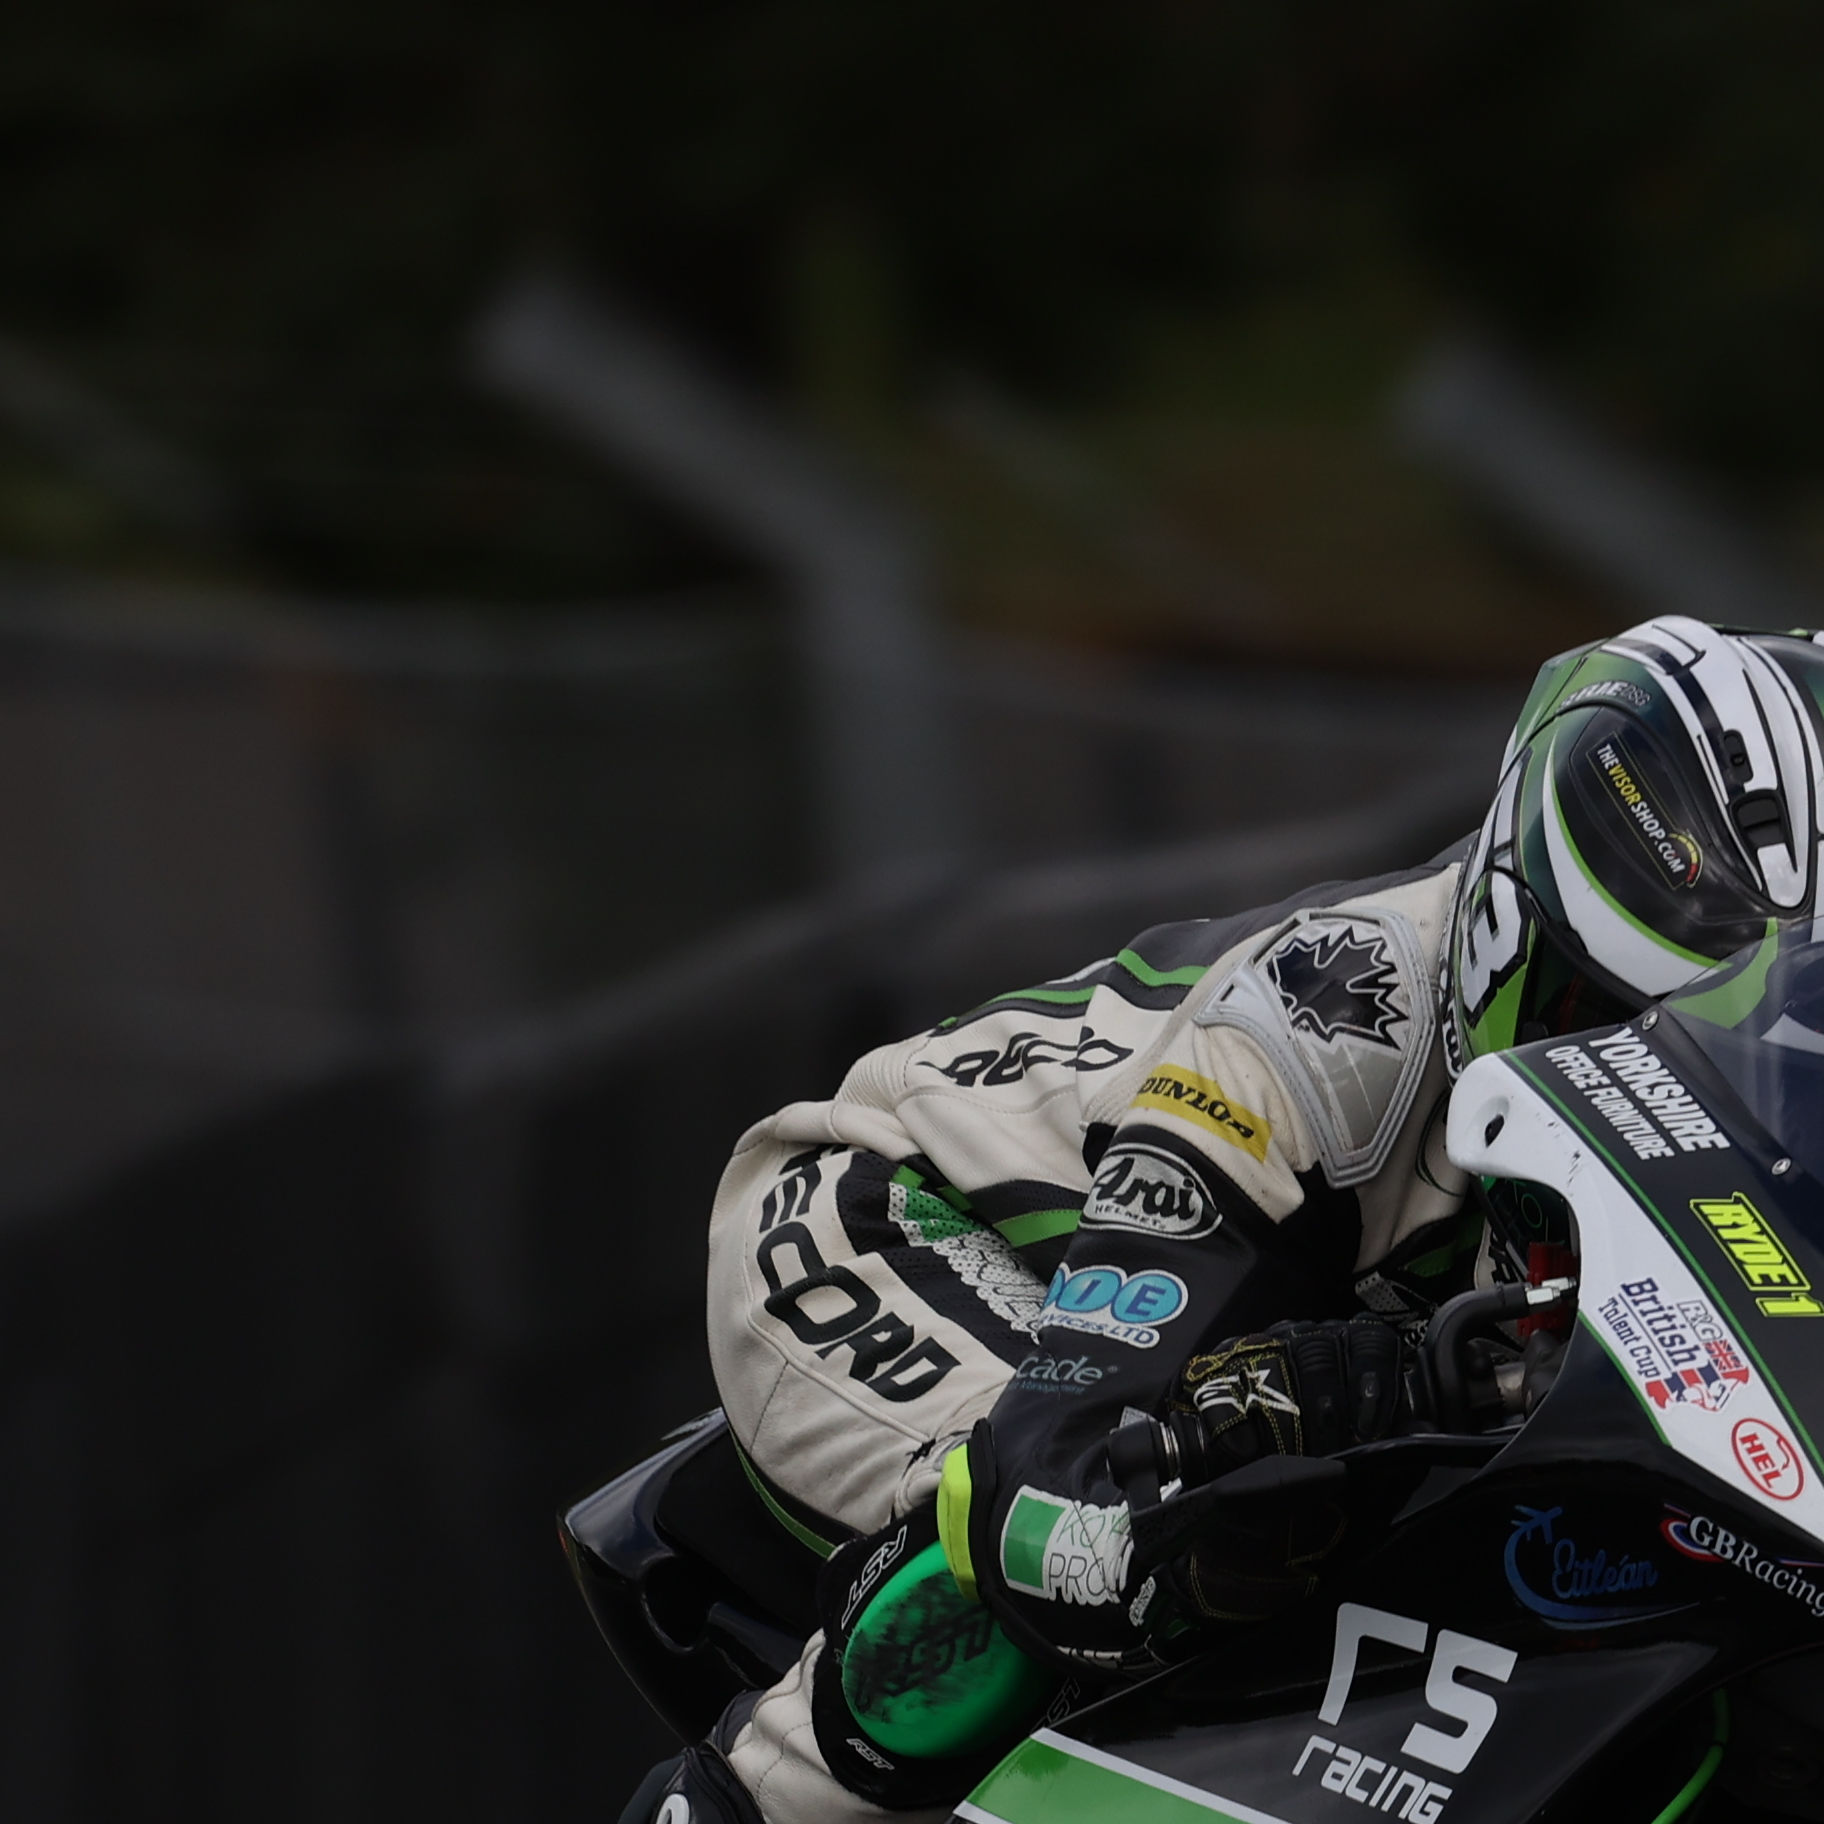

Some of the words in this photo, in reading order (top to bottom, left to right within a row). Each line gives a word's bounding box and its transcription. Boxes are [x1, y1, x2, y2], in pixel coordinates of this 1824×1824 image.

[1596, 743, 1684, 874] THEVISORSHOP.COM
[1138, 1077, 1254, 1138] DUNLOP
[1545, 1045, 1611, 1089] OFFICE
[1583, 1086, 1675, 1160] FURNITURE
[1588, 1026, 1731, 1152] YORKSHIRE
[1093, 1157, 1196, 1220] Arai
[1696, 1198, 1804, 1287] RYDE
[1050, 1279, 1167, 1317] IE
[1109, 1325, 1154, 1344] LTD
[1621, 1277, 1701, 1367] British
[1598, 1299, 1636, 1345] Talent
[1629, 1345, 1661, 1379] Cup
[1739, 1433, 1784, 1489] HEL
